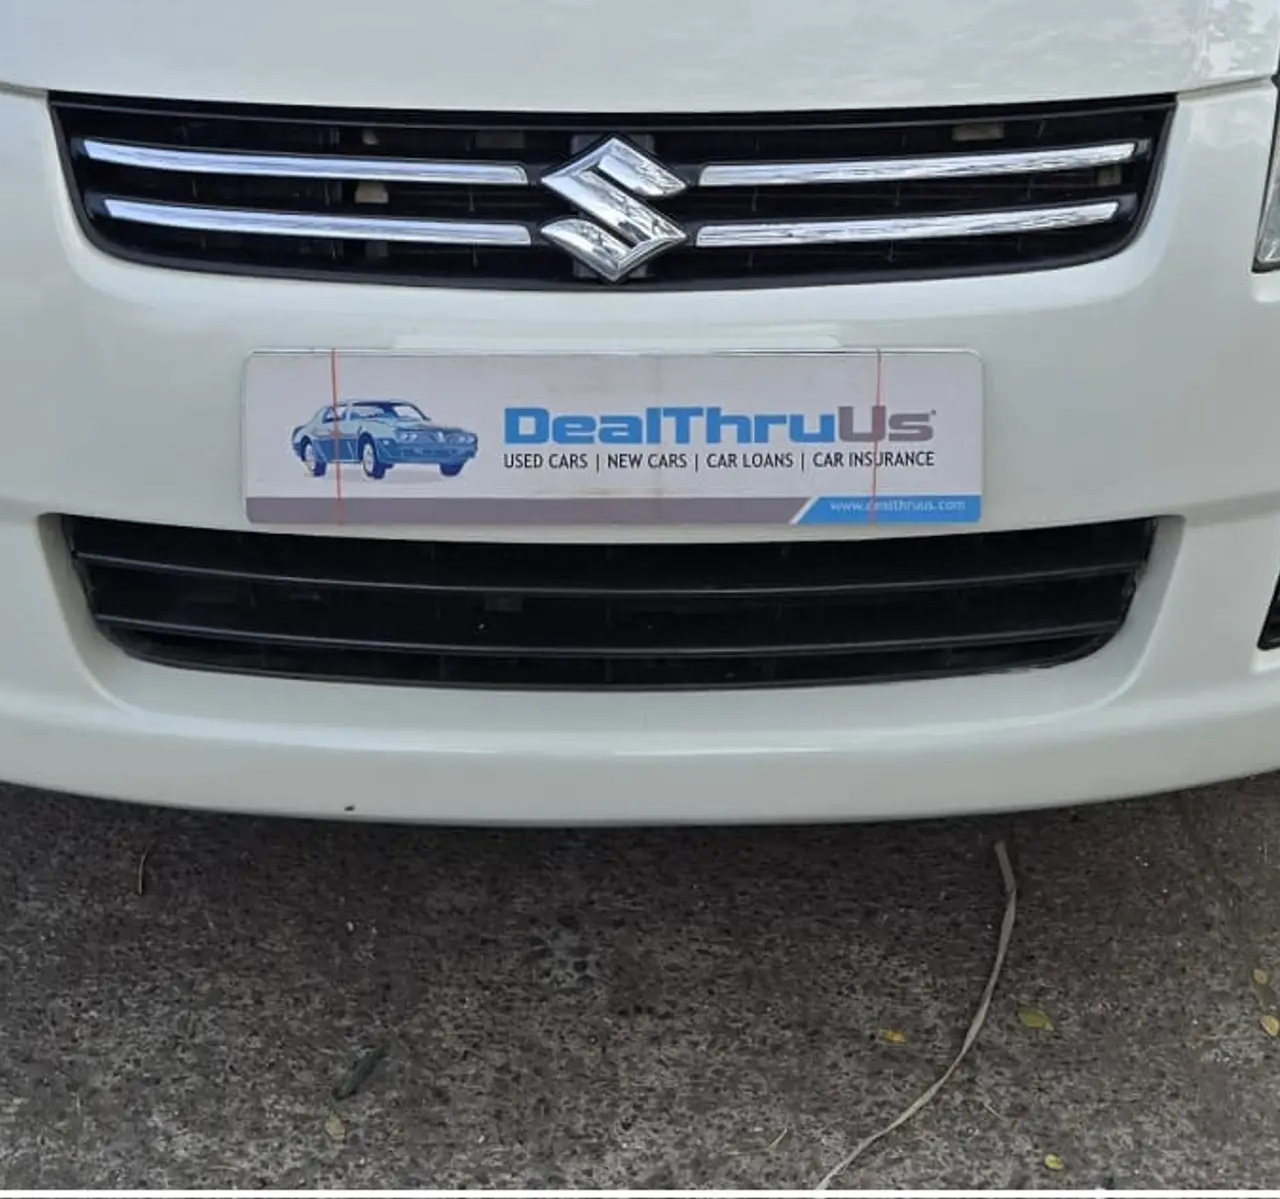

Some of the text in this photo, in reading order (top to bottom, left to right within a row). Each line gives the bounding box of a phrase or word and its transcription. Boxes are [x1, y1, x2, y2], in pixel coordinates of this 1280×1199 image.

[504, 405, 935, 444] DealThruUs
[504, 451, 935, 469] USED CARS NEW CARS CAR LOANS CAR INSURANCE
